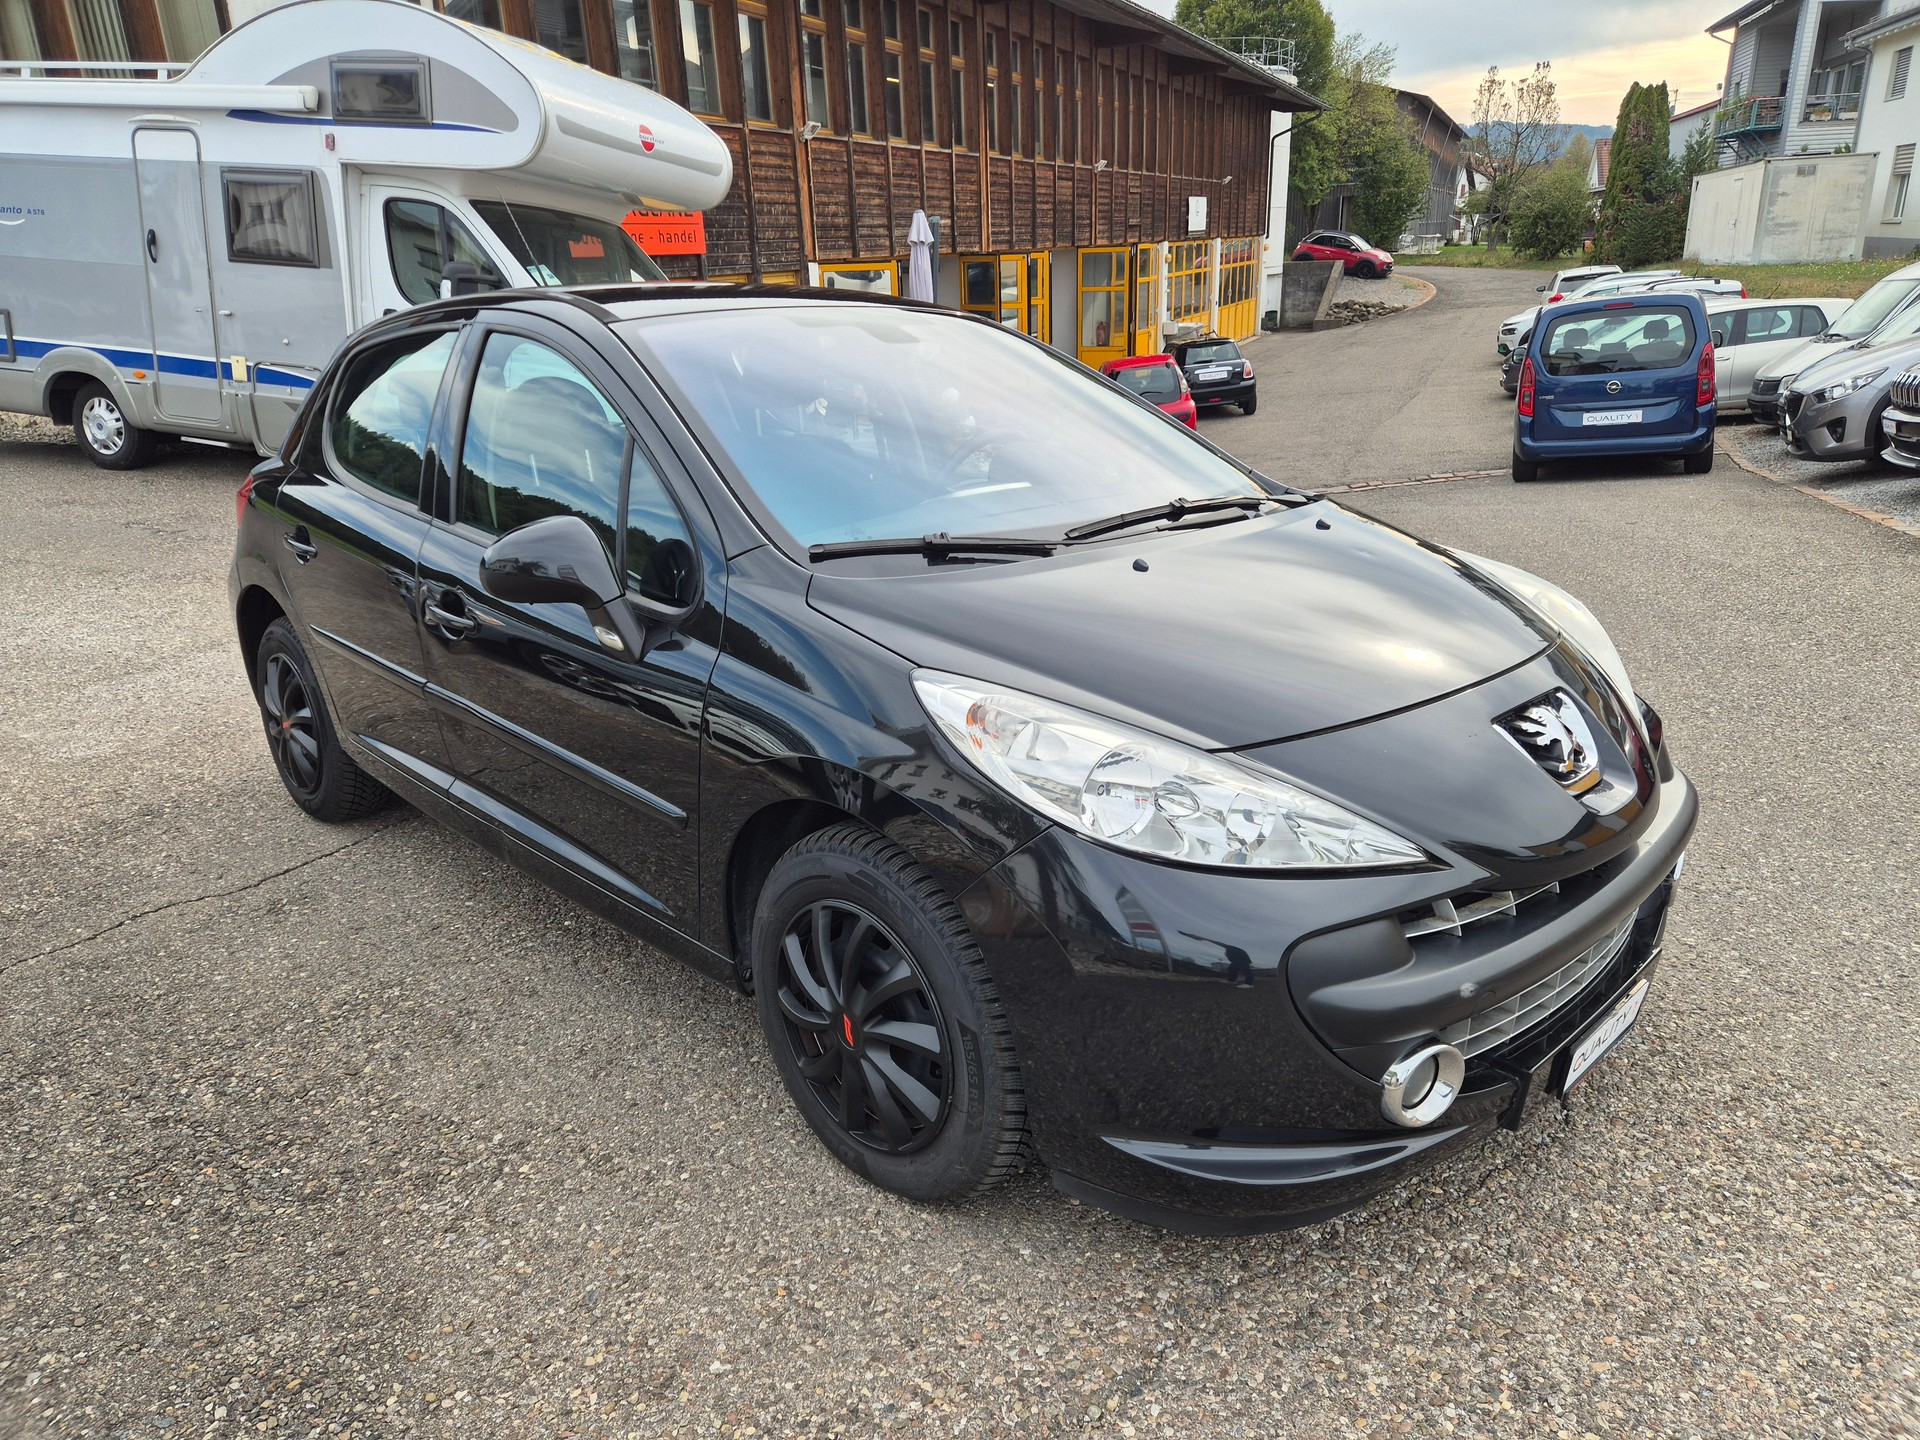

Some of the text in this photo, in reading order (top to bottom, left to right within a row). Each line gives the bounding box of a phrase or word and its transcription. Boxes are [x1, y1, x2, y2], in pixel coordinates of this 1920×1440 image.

[658, 230, 697, 243] handel
[1586, 414, 1632, 423] QUALITY
[1573, 1005, 1633, 1073] QUALITY
[963, 1033, 978, 1085] 185/65
